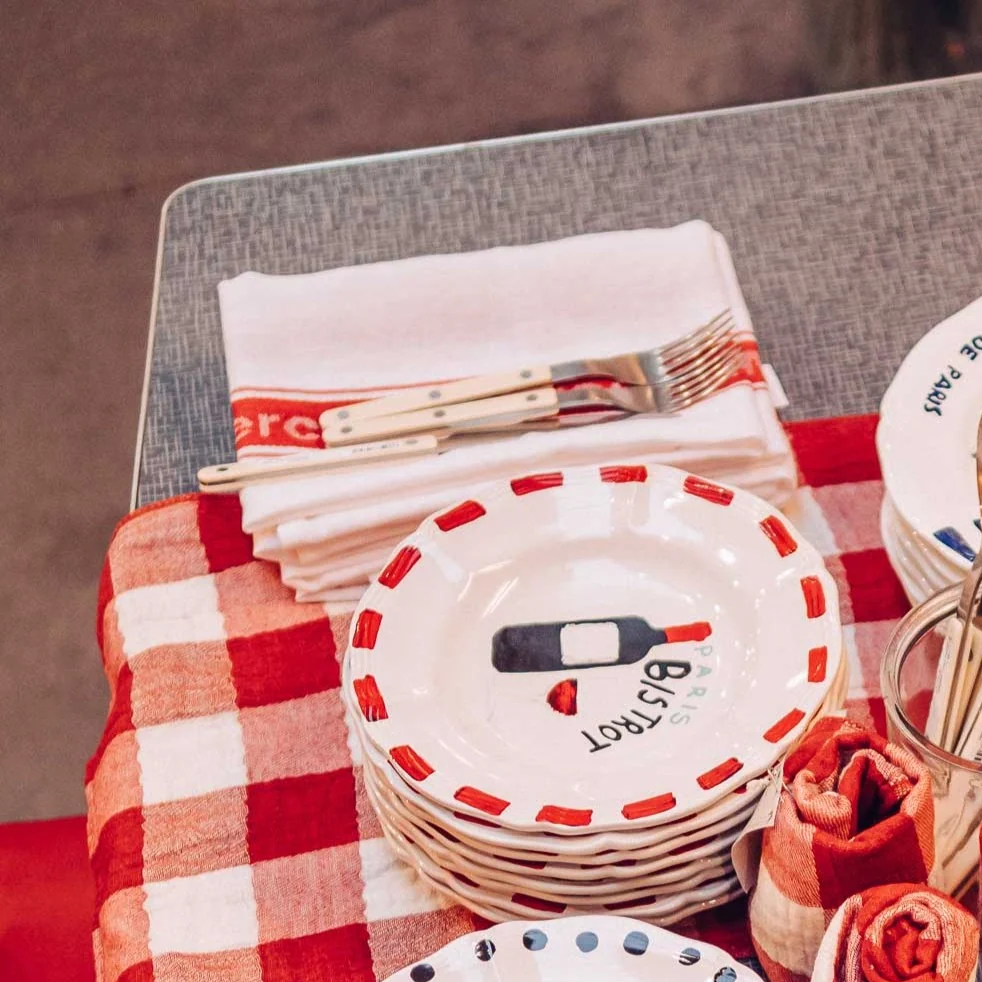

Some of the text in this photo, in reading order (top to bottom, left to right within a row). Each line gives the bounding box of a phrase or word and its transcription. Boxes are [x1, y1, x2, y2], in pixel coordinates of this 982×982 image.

[924, 365, 962, 417] PARIS
[581, 659, 692, 753] BISTROT
[669, 645, 713, 725] PARIS
